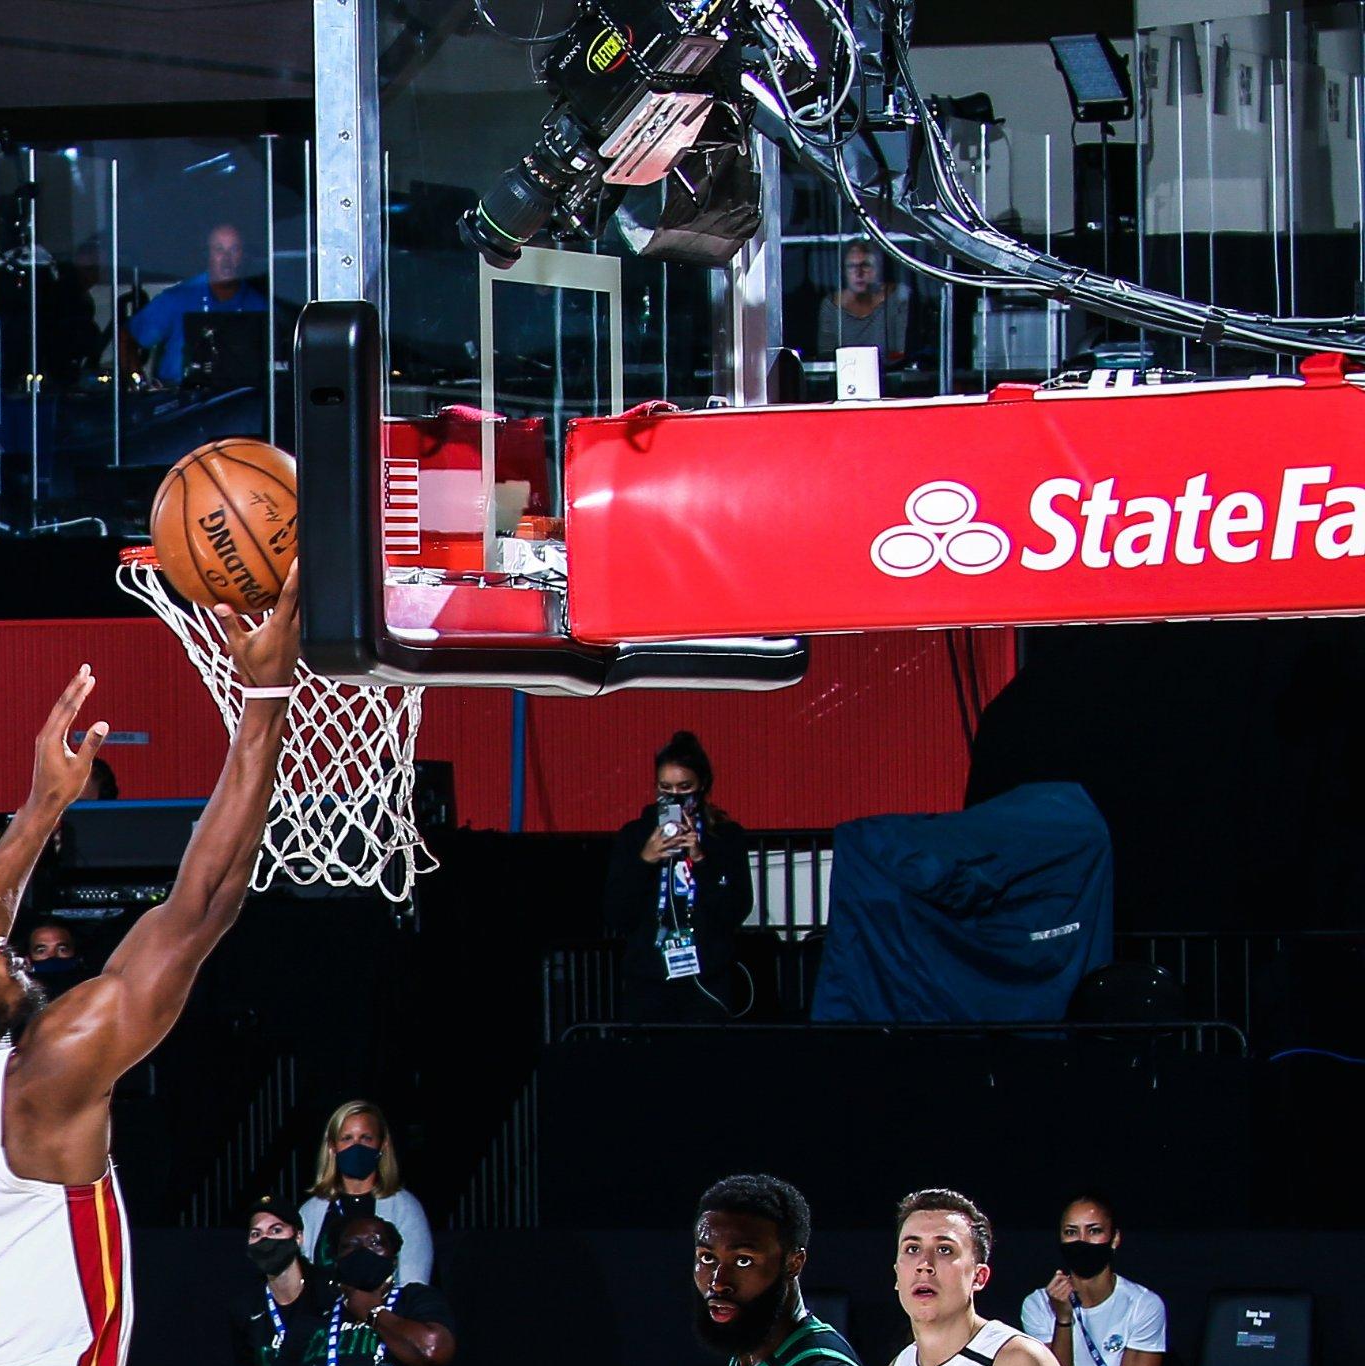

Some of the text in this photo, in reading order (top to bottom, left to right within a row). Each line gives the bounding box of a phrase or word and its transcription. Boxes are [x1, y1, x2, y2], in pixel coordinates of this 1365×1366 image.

[558, 41, 582, 70] SONY
[1020, 465, 1365, 571] State Fa
